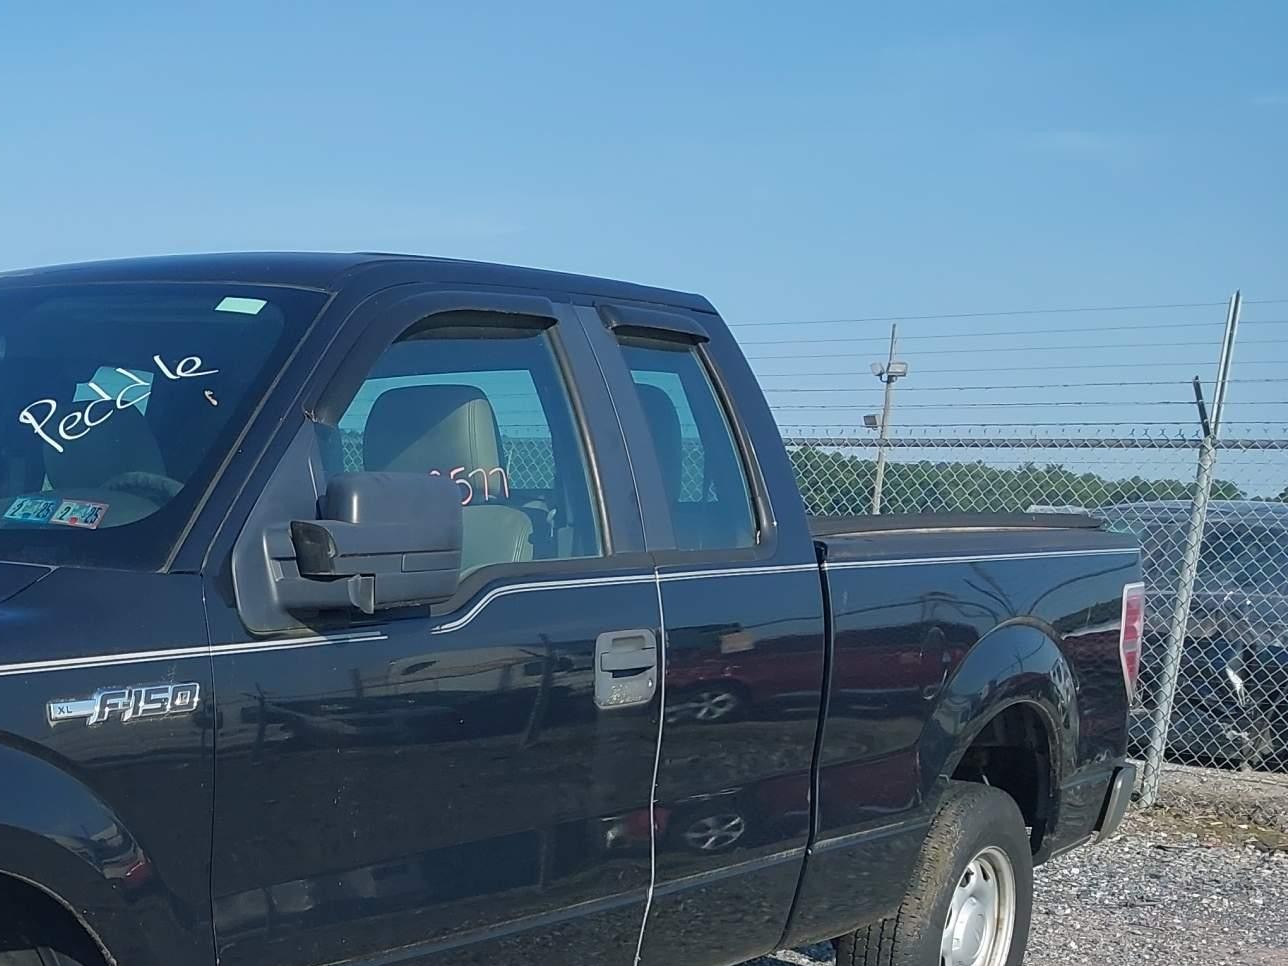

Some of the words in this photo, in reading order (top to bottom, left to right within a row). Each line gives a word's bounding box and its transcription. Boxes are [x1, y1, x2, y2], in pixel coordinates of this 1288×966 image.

[19, 354, 219, 453] Peddle
[430, 466, 509, 505] 577
[57, 705, 73, 715] XL
